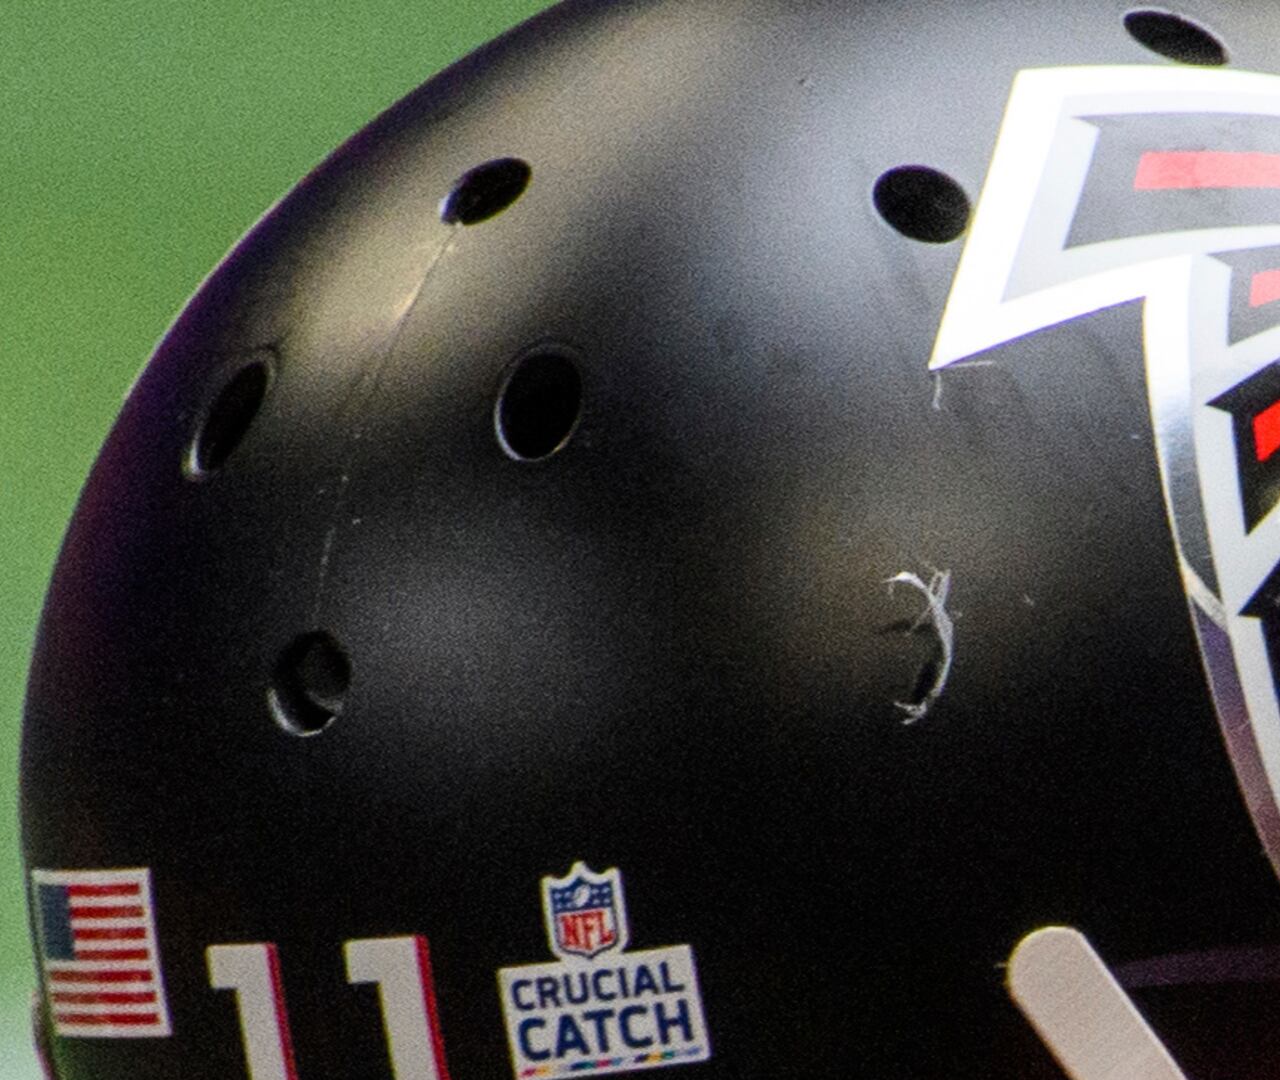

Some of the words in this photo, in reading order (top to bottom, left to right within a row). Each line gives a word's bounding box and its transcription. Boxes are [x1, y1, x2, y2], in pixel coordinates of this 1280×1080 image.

[560, 911, 616, 951] NFL
[511, 961, 685, 1010] CRUCIAL
[518, 999, 694, 1061] CATCH
